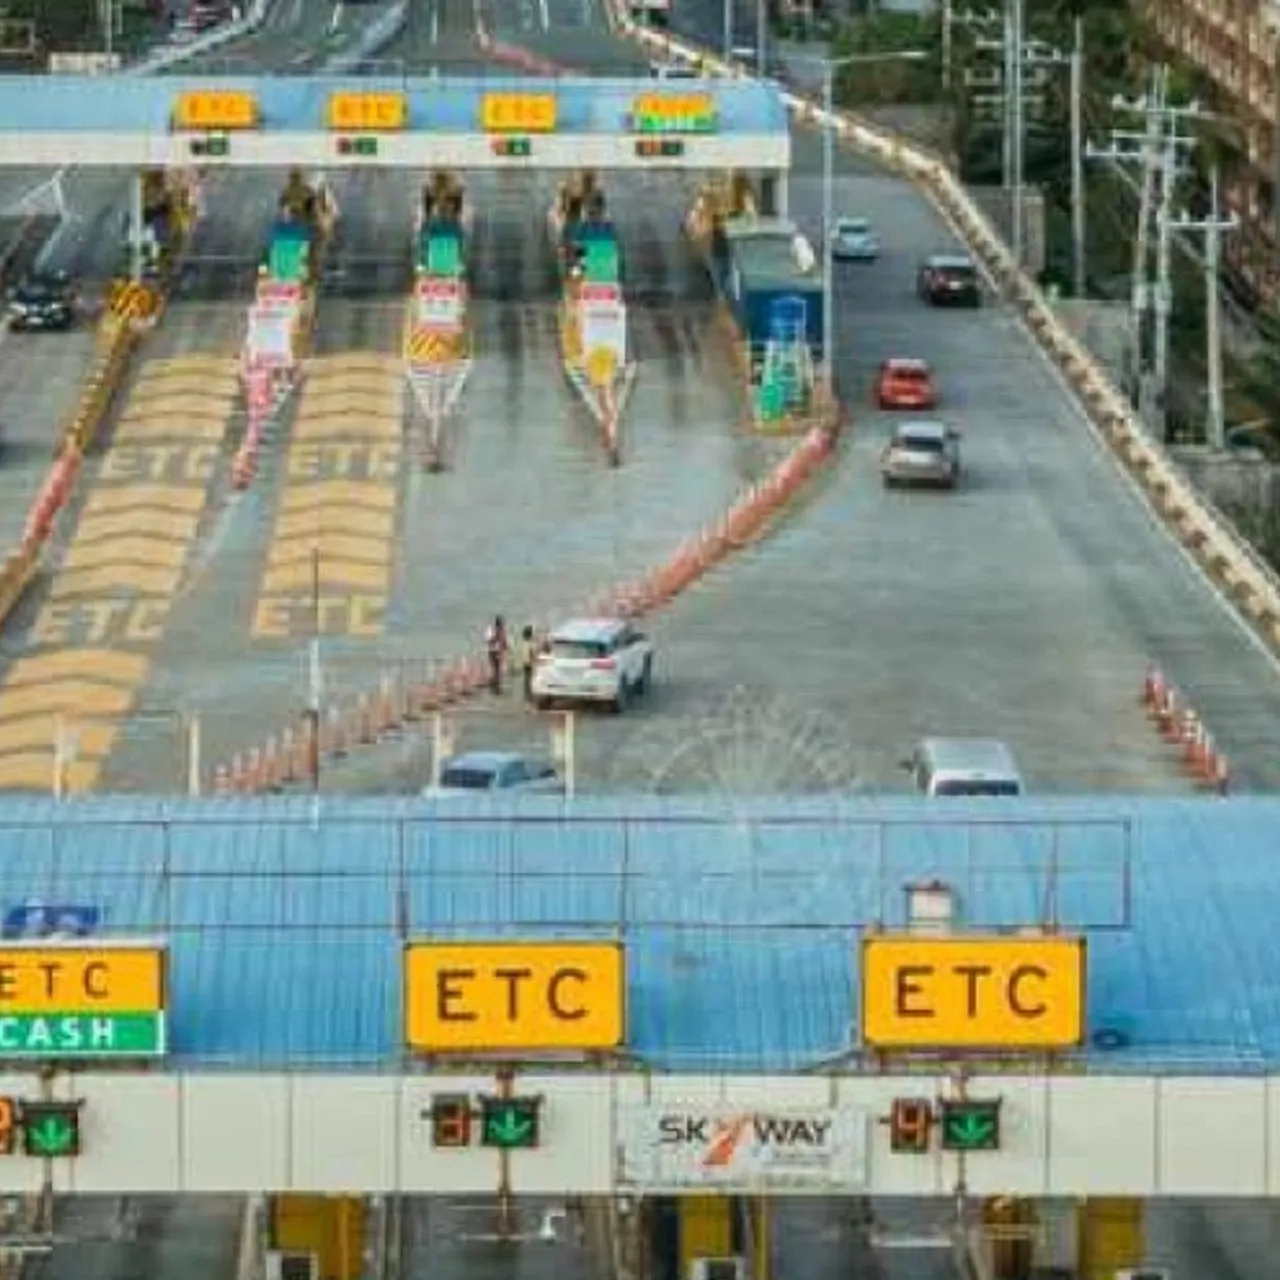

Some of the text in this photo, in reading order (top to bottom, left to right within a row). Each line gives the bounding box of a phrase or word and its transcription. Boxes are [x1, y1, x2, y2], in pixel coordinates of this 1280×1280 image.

[27, 602, 172, 645] ETC
[435, 968, 589, 1022] ETC
[894, 965, 1050, 1020] ETC
